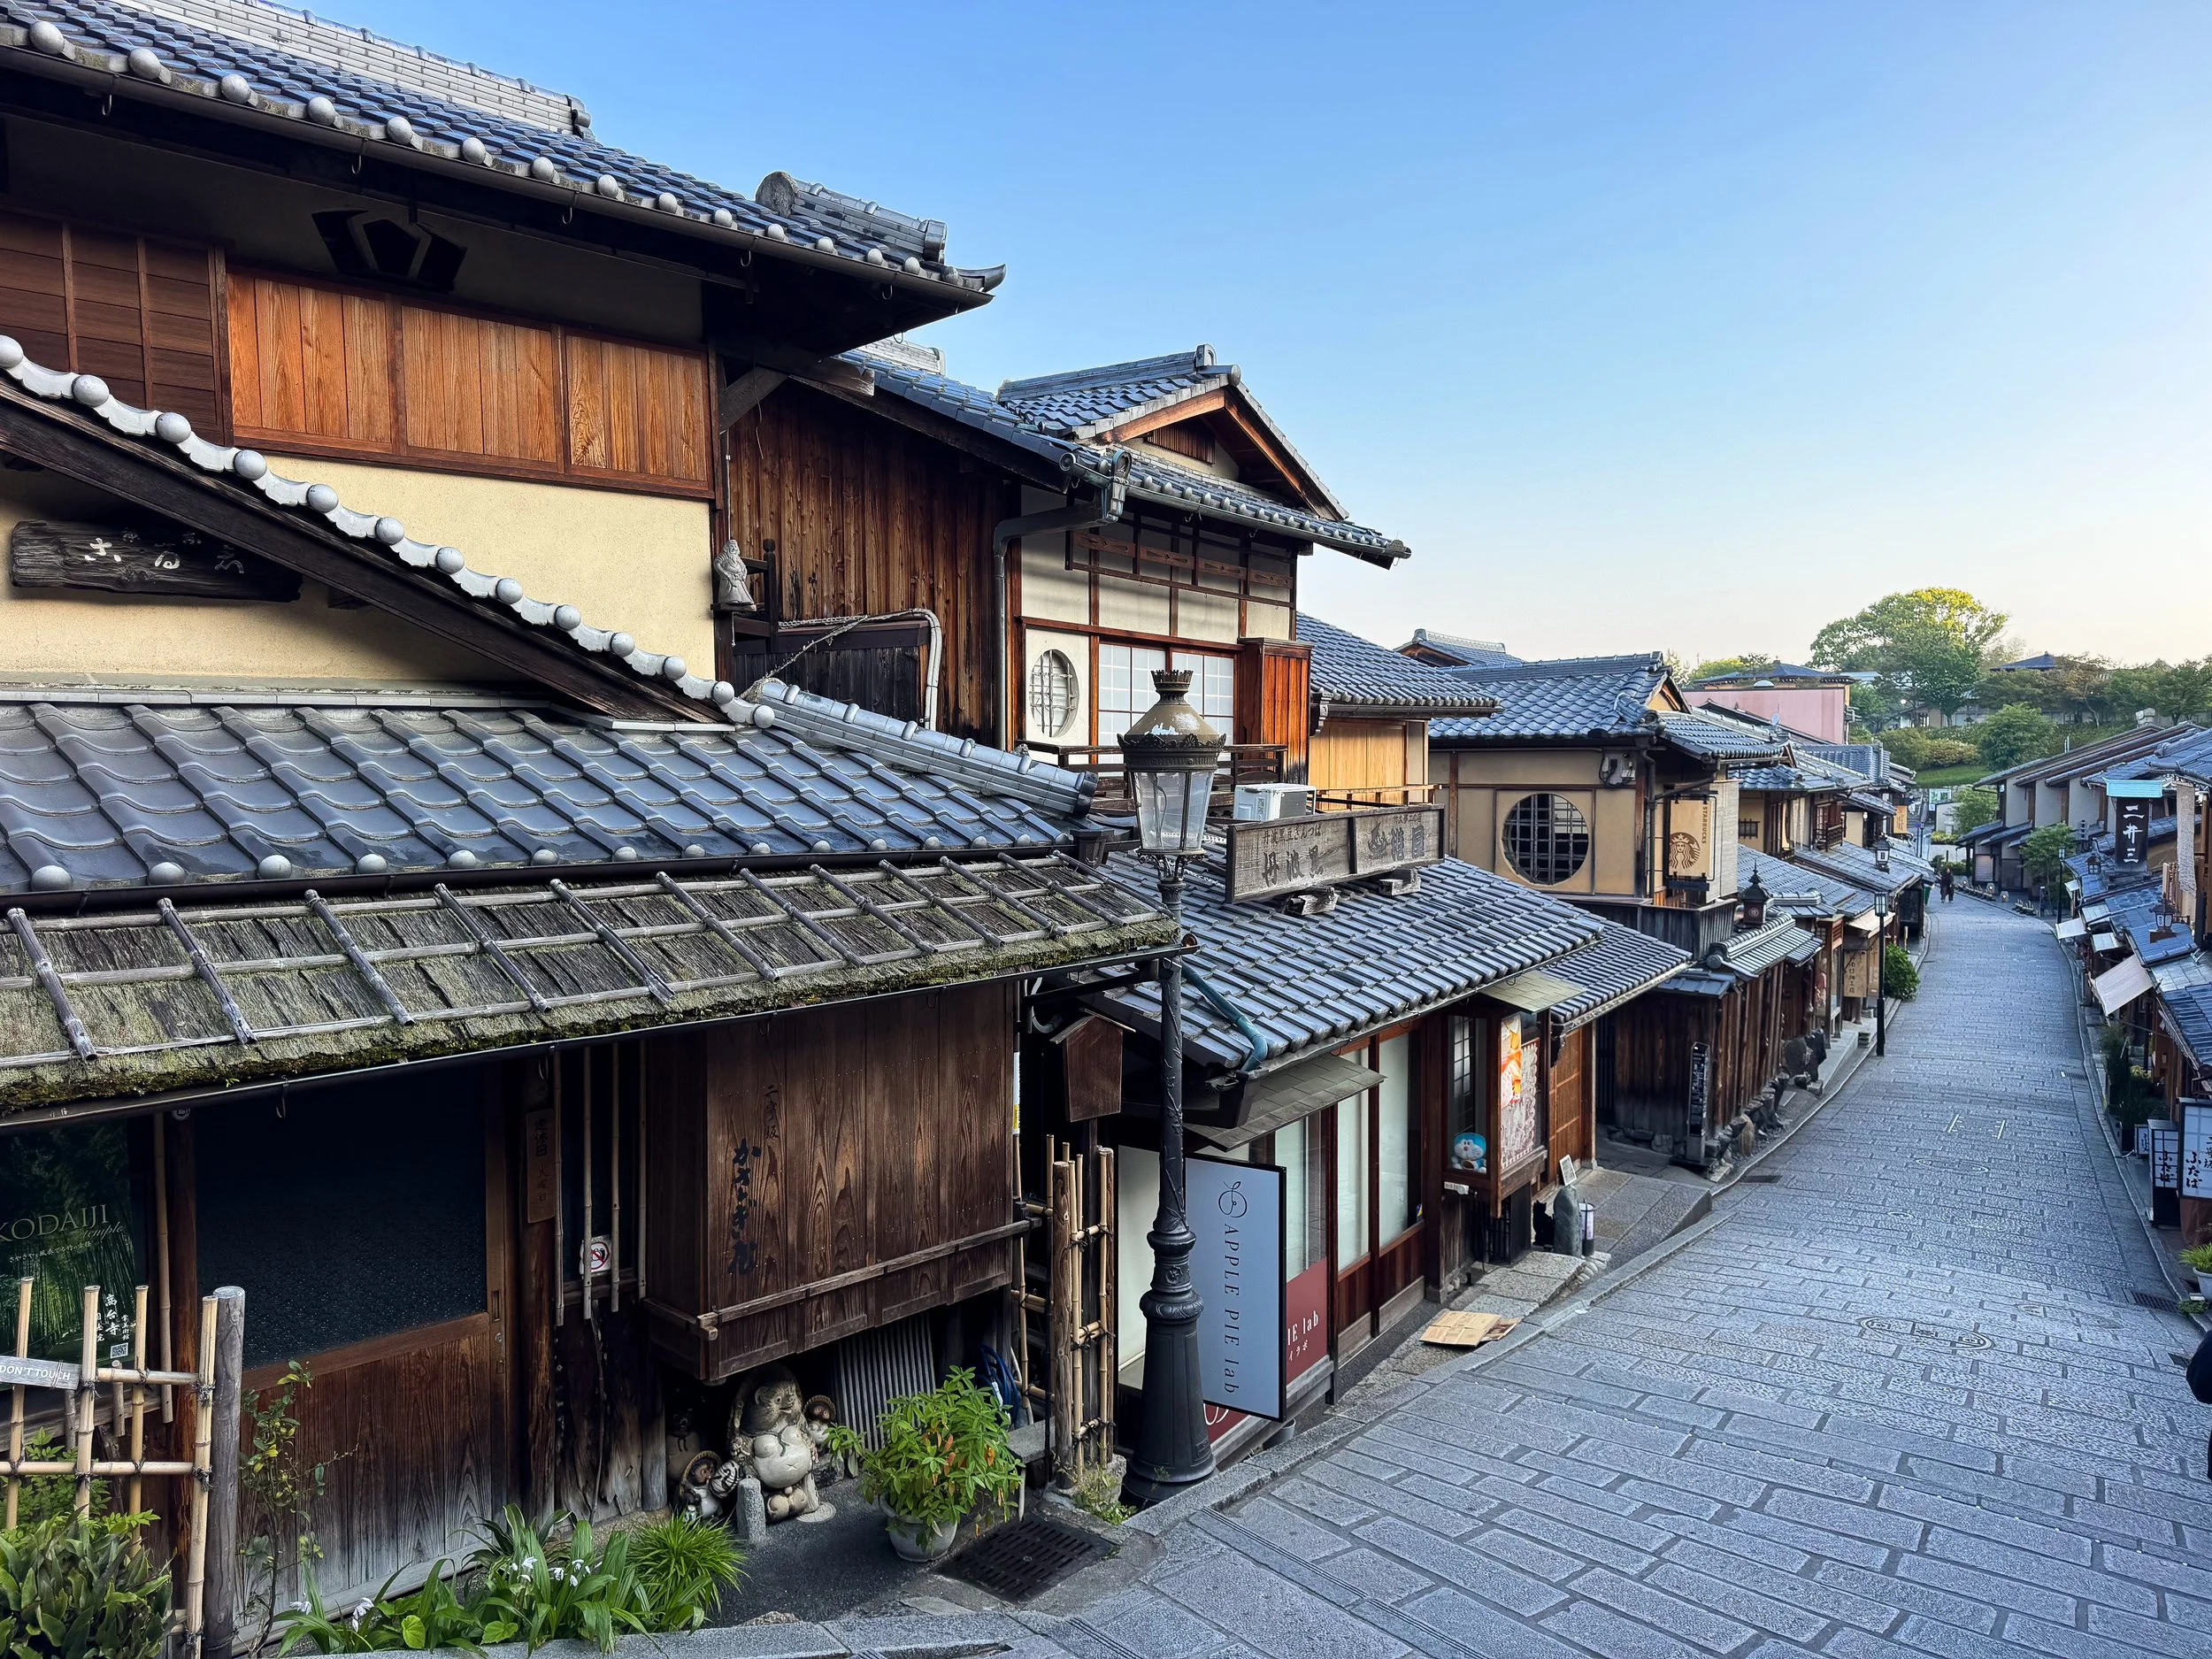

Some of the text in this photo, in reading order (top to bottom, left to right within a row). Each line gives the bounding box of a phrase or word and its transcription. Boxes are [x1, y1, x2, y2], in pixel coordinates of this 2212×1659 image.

[2159, 1149, 2174, 1183] ふたば
[2185, 1151, 2202, 1189] ふたば
[0, 1204, 109, 1241] KODAIJI
[104, 1294, 120, 1336] 高台寺
[1224, 1224, 1240, 1394] APPLE PIE lab
[1287, 1309, 1319, 1346] IE lab
[1288, 1339, 1309, 1362] イラボ
[0, 1364, 34, 1377] DON'T
